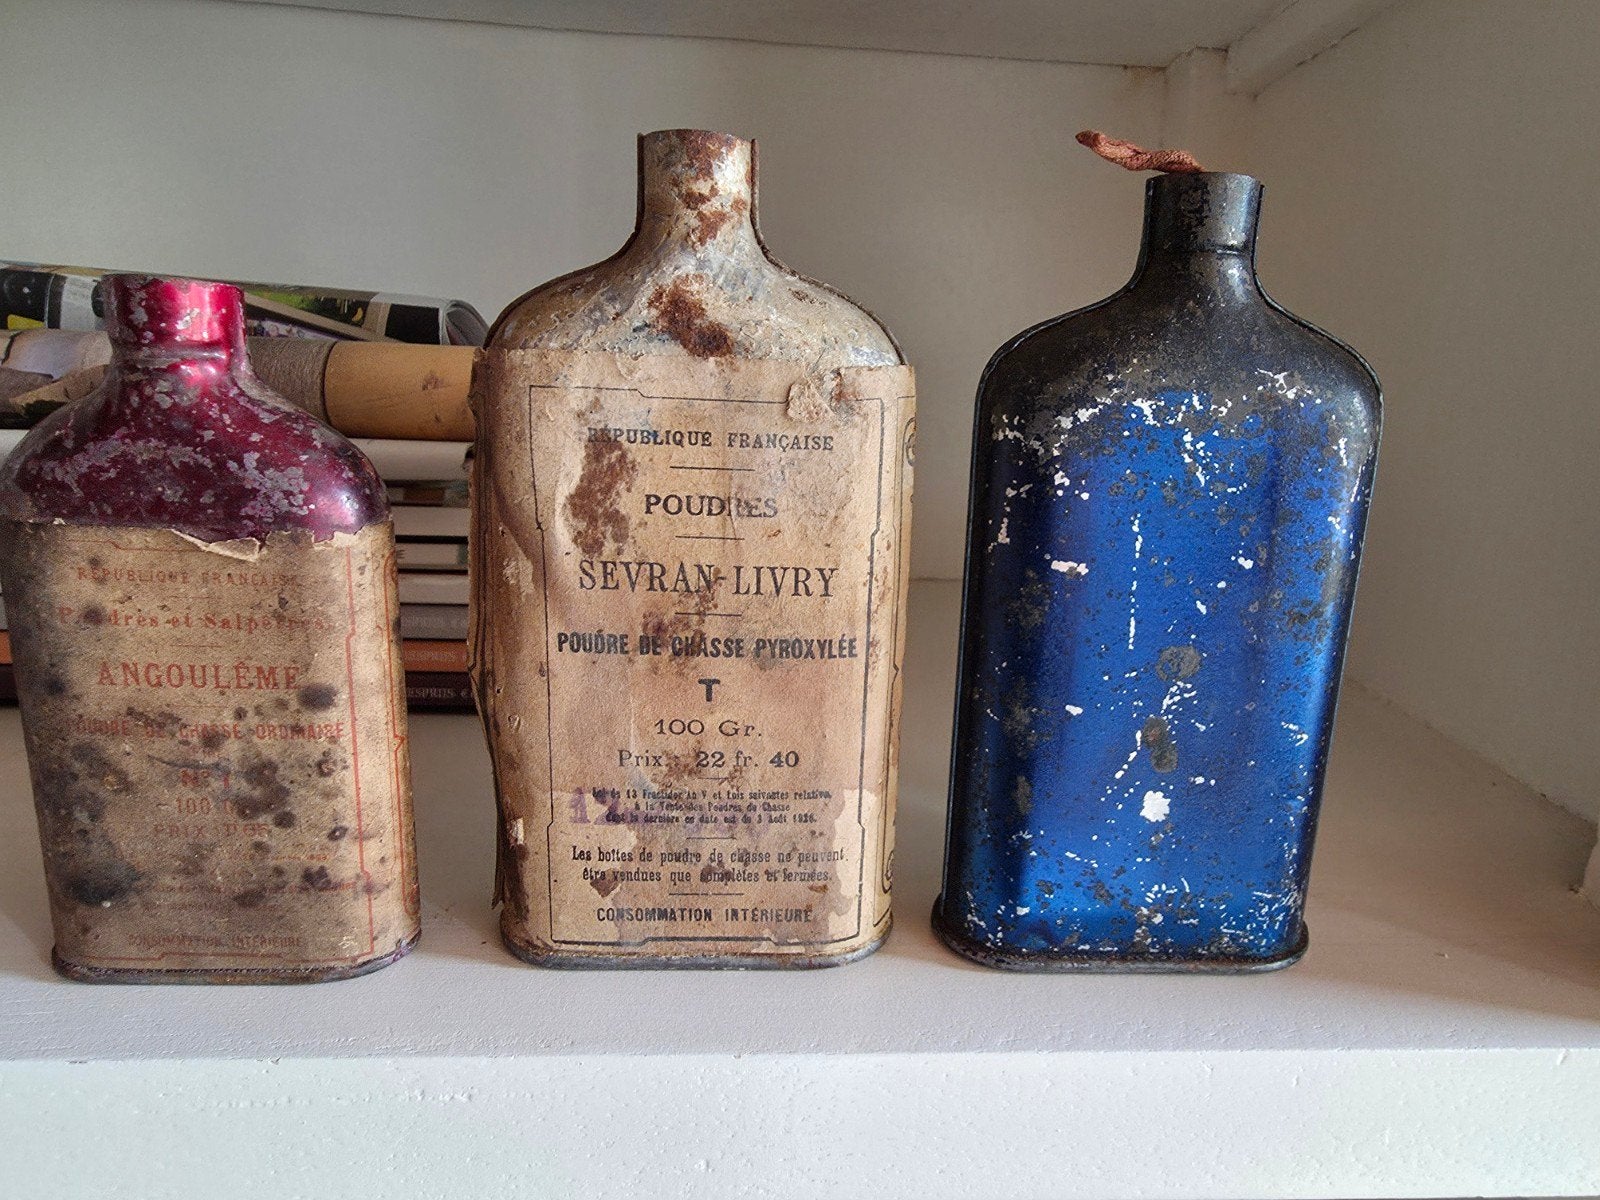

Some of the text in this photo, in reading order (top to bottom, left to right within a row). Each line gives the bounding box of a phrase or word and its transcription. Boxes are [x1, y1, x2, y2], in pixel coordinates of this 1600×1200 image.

[727, 432, 834, 452] FRANÇAISE
[644, 494, 778, 518] POUDRES
[557, 631, 858, 660] POUDRE DE CHASSE PYROXYLÉE
[97, 660, 301, 691] ANGOULÊME
[698, 678, 721, 702] T
[654, 718, 763, 737] 100 Gr.
[696, 750, 726, 768] 22
[735, 750, 759, 768] fr.
[769, 750, 800, 768] 40
[572, 845, 592, 861] Les
[640, 847, 653, 863] de
[661, 847, 702, 867] poudre
[709, 848, 724, 864] de
[730, 847, 771, 864] chasse
[778, 852, 792, 863] ne
[613, 867, 661, 882] vendues
[670, 870, 692, 886] que
[597, 906, 813, 923] CONSOMMATION INTÉRIEURE
